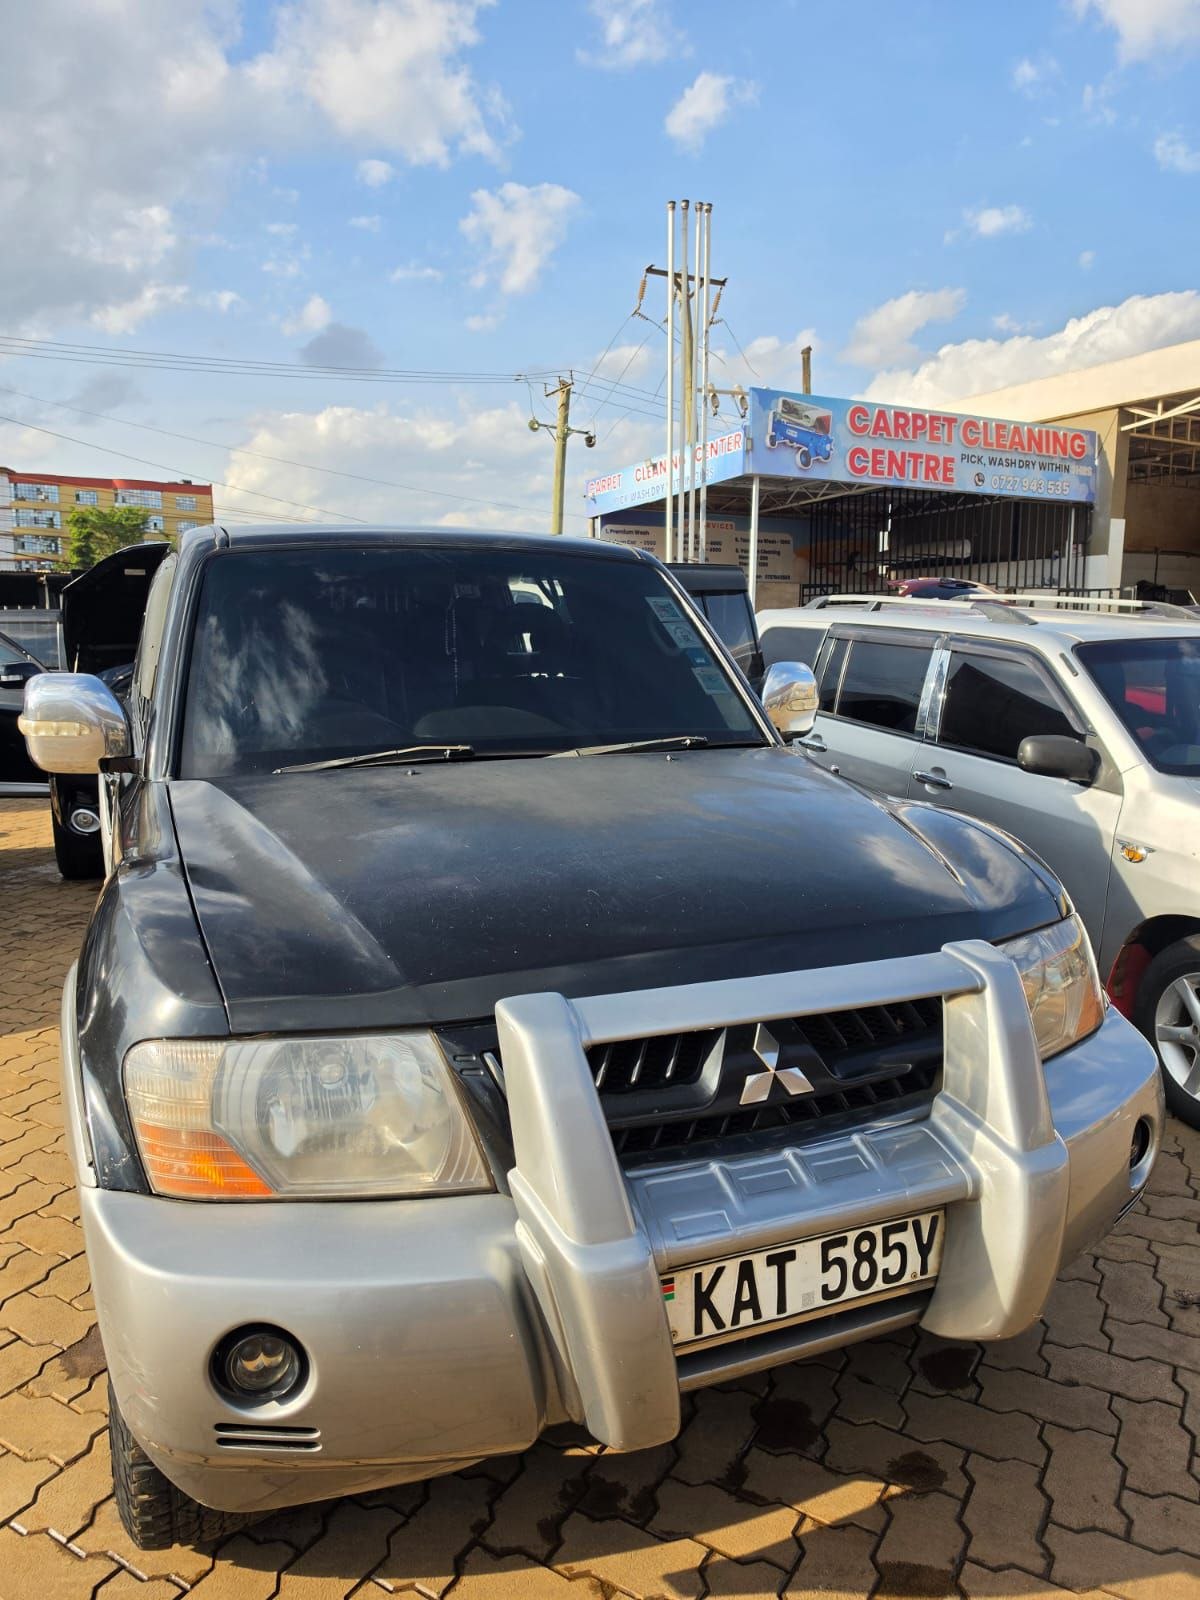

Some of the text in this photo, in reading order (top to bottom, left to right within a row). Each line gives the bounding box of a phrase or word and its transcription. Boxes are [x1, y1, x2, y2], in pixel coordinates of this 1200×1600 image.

[848, 405, 1087, 459] CARPET CLEANING
[848, 447, 956, 484] CENTRE
[960, 453, 986, 468] PICK,
[1038, 461, 1070, 474] WITHIN
[588, 474, 622, 494] CARPET
[991, 474, 1070, 496] 0727 943 535
[693, 1214, 939, 1336] KAT 585Y
